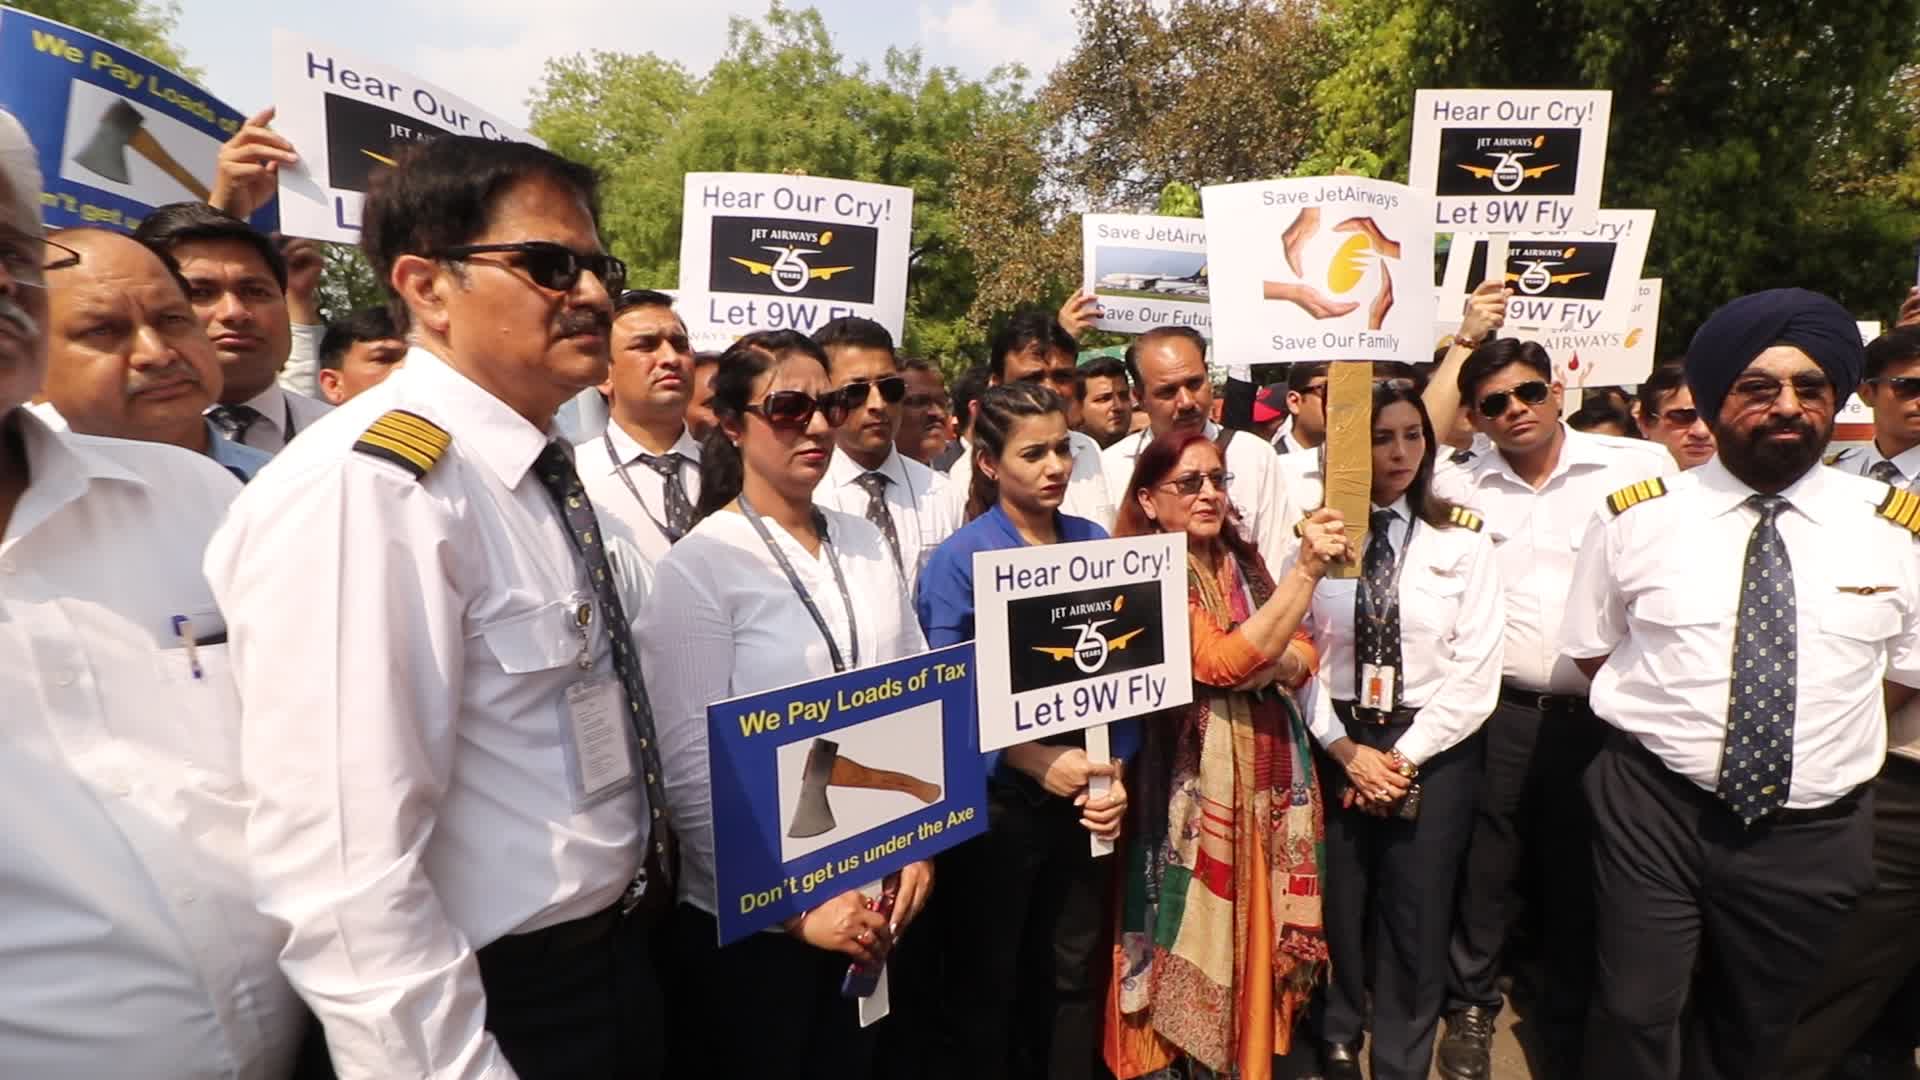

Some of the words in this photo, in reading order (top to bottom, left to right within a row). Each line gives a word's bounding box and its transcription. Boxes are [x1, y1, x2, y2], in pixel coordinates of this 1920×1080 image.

[32, 29, 84, 64] We
[91, 51, 144, 90] Pay
[149, 75, 217, 123] Loads
[307, 51, 402, 102] Hear
[413, 89, 471, 130] Our
[1433, 100, 1490, 121] Hear
[1497, 101, 1540, 121] Our
[1547, 101, 1594, 126] Cry!
[389, 123, 413, 139] JET
[1476, 138, 1491, 150] JET
[1493, 137, 1533, 147] AIRWAYS
[703, 185, 765, 208] Hear
[773, 187, 826, 213] Our
[834, 193, 892, 225] Cry!
[1263, 190, 1309, 206] Save
[1315, 186, 1398, 209] JetAirways
[1436, 201, 1478, 224] Let
[1486, 200, 1529, 224] 9W
[1536, 200, 1573, 229] Fly
[751, 228, 768, 242] JET
[770, 230, 818, 243] AIRWAYS
[1097, 223, 1140, 239] Save
[1145, 226, 1207, 244] JetAirw
[1523, 249, 1564, 257] AIRWAYS
[1638, 286, 1651, 296] to
[709, 298, 757, 326] Let
[767, 302, 818, 330] 9W
[1095, 304, 1134, 320] Save
[1140, 307, 1168, 323] Our
[1173, 310, 1212, 327] Futu
[1510, 300, 1553, 321] 9W
[1560, 302, 1602, 328] Fly
[1272, 335, 1317, 350] Save
[1322, 332, 1354, 348] Our
[1358, 332, 1399, 352] Family
[1543, 333, 1619, 350] AIRWAYS
[995, 564, 1060, 592] Hear
[1069, 556, 1115, 582] Our
[1122, 546, 1171, 578] Cry!
[1051, 607, 1067, 624] JET
[1069, 599, 1113, 616] AIRWAYS
[1081, 649, 1101, 659] YEARS
[739, 709, 781, 737] We
[788, 698, 831, 724] Pay
[837, 677, 902, 712] Loads
[908, 671, 928, 692] of
[934, 662, 966, 684] Tax
[1015, 692, 1065, 731] Let
[1073, 679, 1119, 718] 9W
[1129, 673, 1166, 707] Fly
[739, 876, 799, 914] Don't
[802, 862, 835, 893] get
[837, 853, 859, 873] us
[864, 830, 914, 862] under
[917, 820, 943, 840] the
[946, 806, 974, 828] Axe
